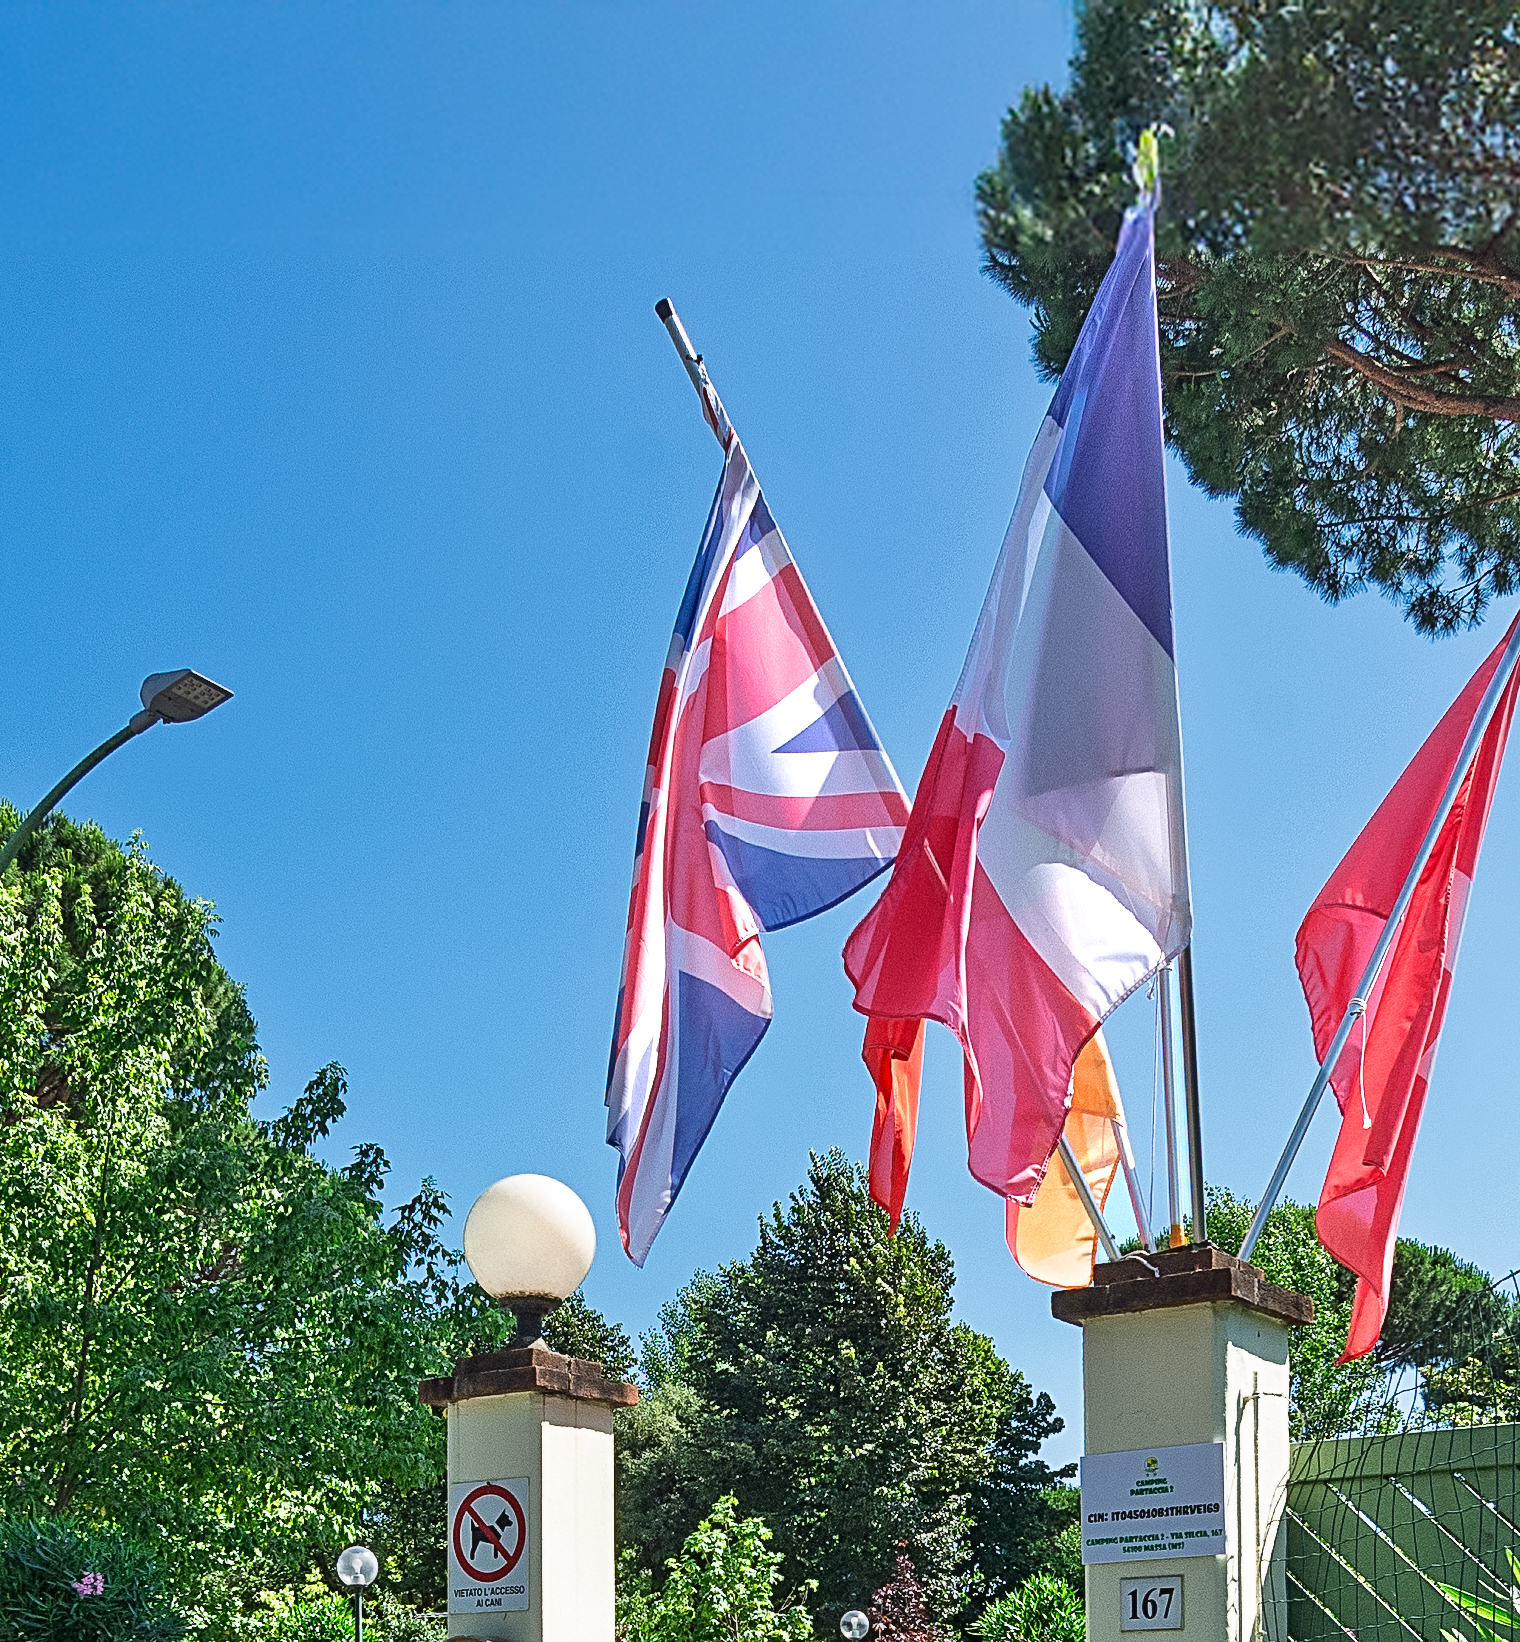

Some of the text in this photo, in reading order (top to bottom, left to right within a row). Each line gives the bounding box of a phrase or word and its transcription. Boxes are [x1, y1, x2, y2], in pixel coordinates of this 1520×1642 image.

[1136, 1478, 1167, 1487] CAMPING
[1130, 1486, 1169, 1496] PARTACCIA
[1087, 1512, 1109, 1523] CIN:
[1086, 1537, 1118, 1546] CAMPING
[1119, 1533, 1160, 1543] PARTACCIA
[1144, 1544, 1167, 1552] MASSA
[454, 1585, 525, 1597] VIETATO L'ACCESSO
[476, 1598, 502, 1607] AI CANI
[1127, 1587, 1175, 1620] 167
